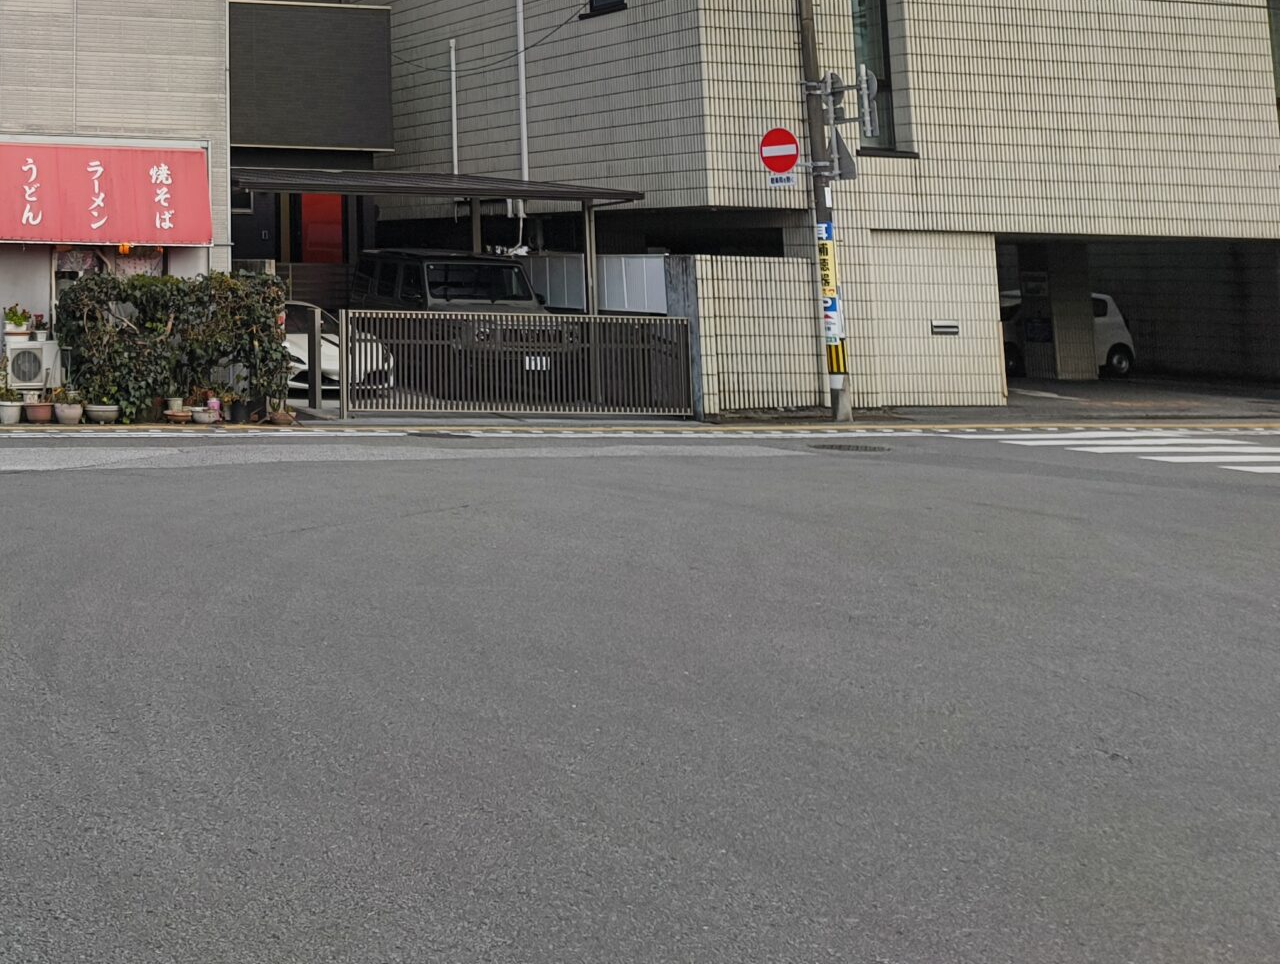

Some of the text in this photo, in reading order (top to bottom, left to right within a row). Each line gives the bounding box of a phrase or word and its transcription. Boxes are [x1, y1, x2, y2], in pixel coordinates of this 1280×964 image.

[21, 157, 42, 226] うどん
[86, 160, 108, 230] ラーメン
[149, 163, 175, 230] 焼そば
